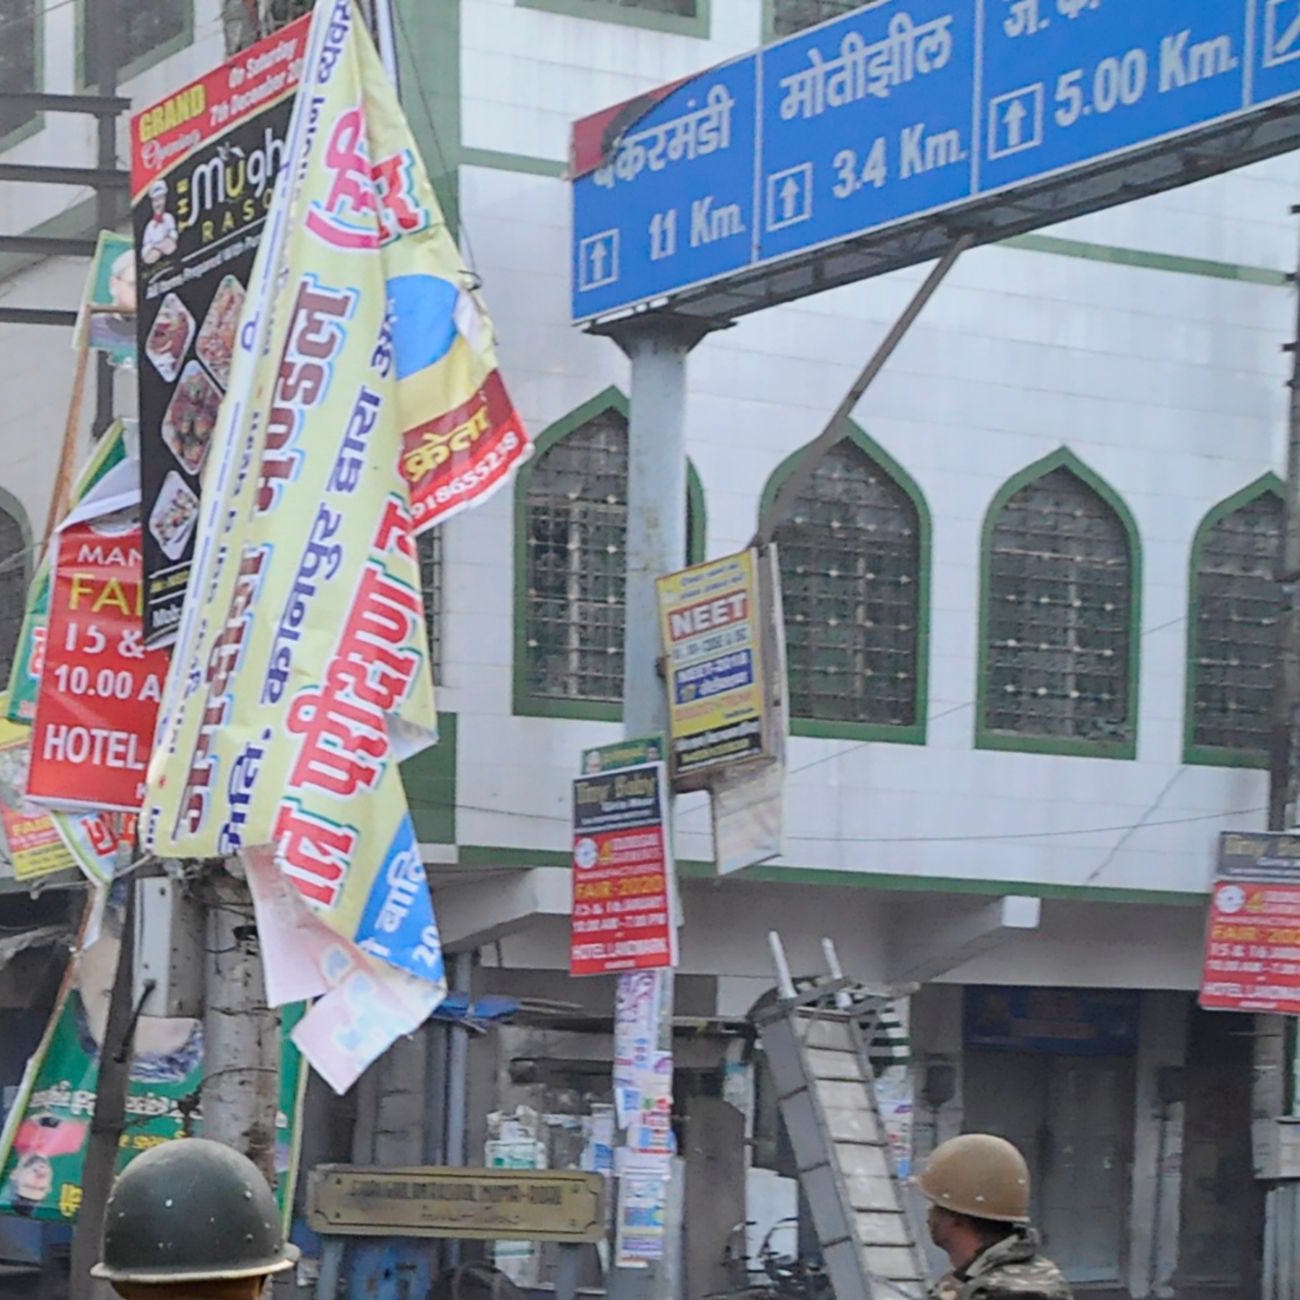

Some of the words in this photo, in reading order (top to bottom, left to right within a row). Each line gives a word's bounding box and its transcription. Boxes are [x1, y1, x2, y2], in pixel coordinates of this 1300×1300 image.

[780, 12, 953, 120] मोतीझील
[1054, 47, 1148, 128] 5.00
[1158, 29, 1240, 94] Km.
[139, 83, 207, 143] GRAND
[832, 136, 888, 198] 3.4
[900, 122, 967, 180] Km.
[689, 195, 747, 248] Km.
[262, 501, 342, 704] कानपुर
[325, 386, 384, 494] द्वारा
[65, 621, 107, 655] 15
[117, 628, 145, 659] &
[669, 591, 748, 639] NEET
[53, 662, 133, 700] 10.00
[43, 723, 145, 771] HOTEL
